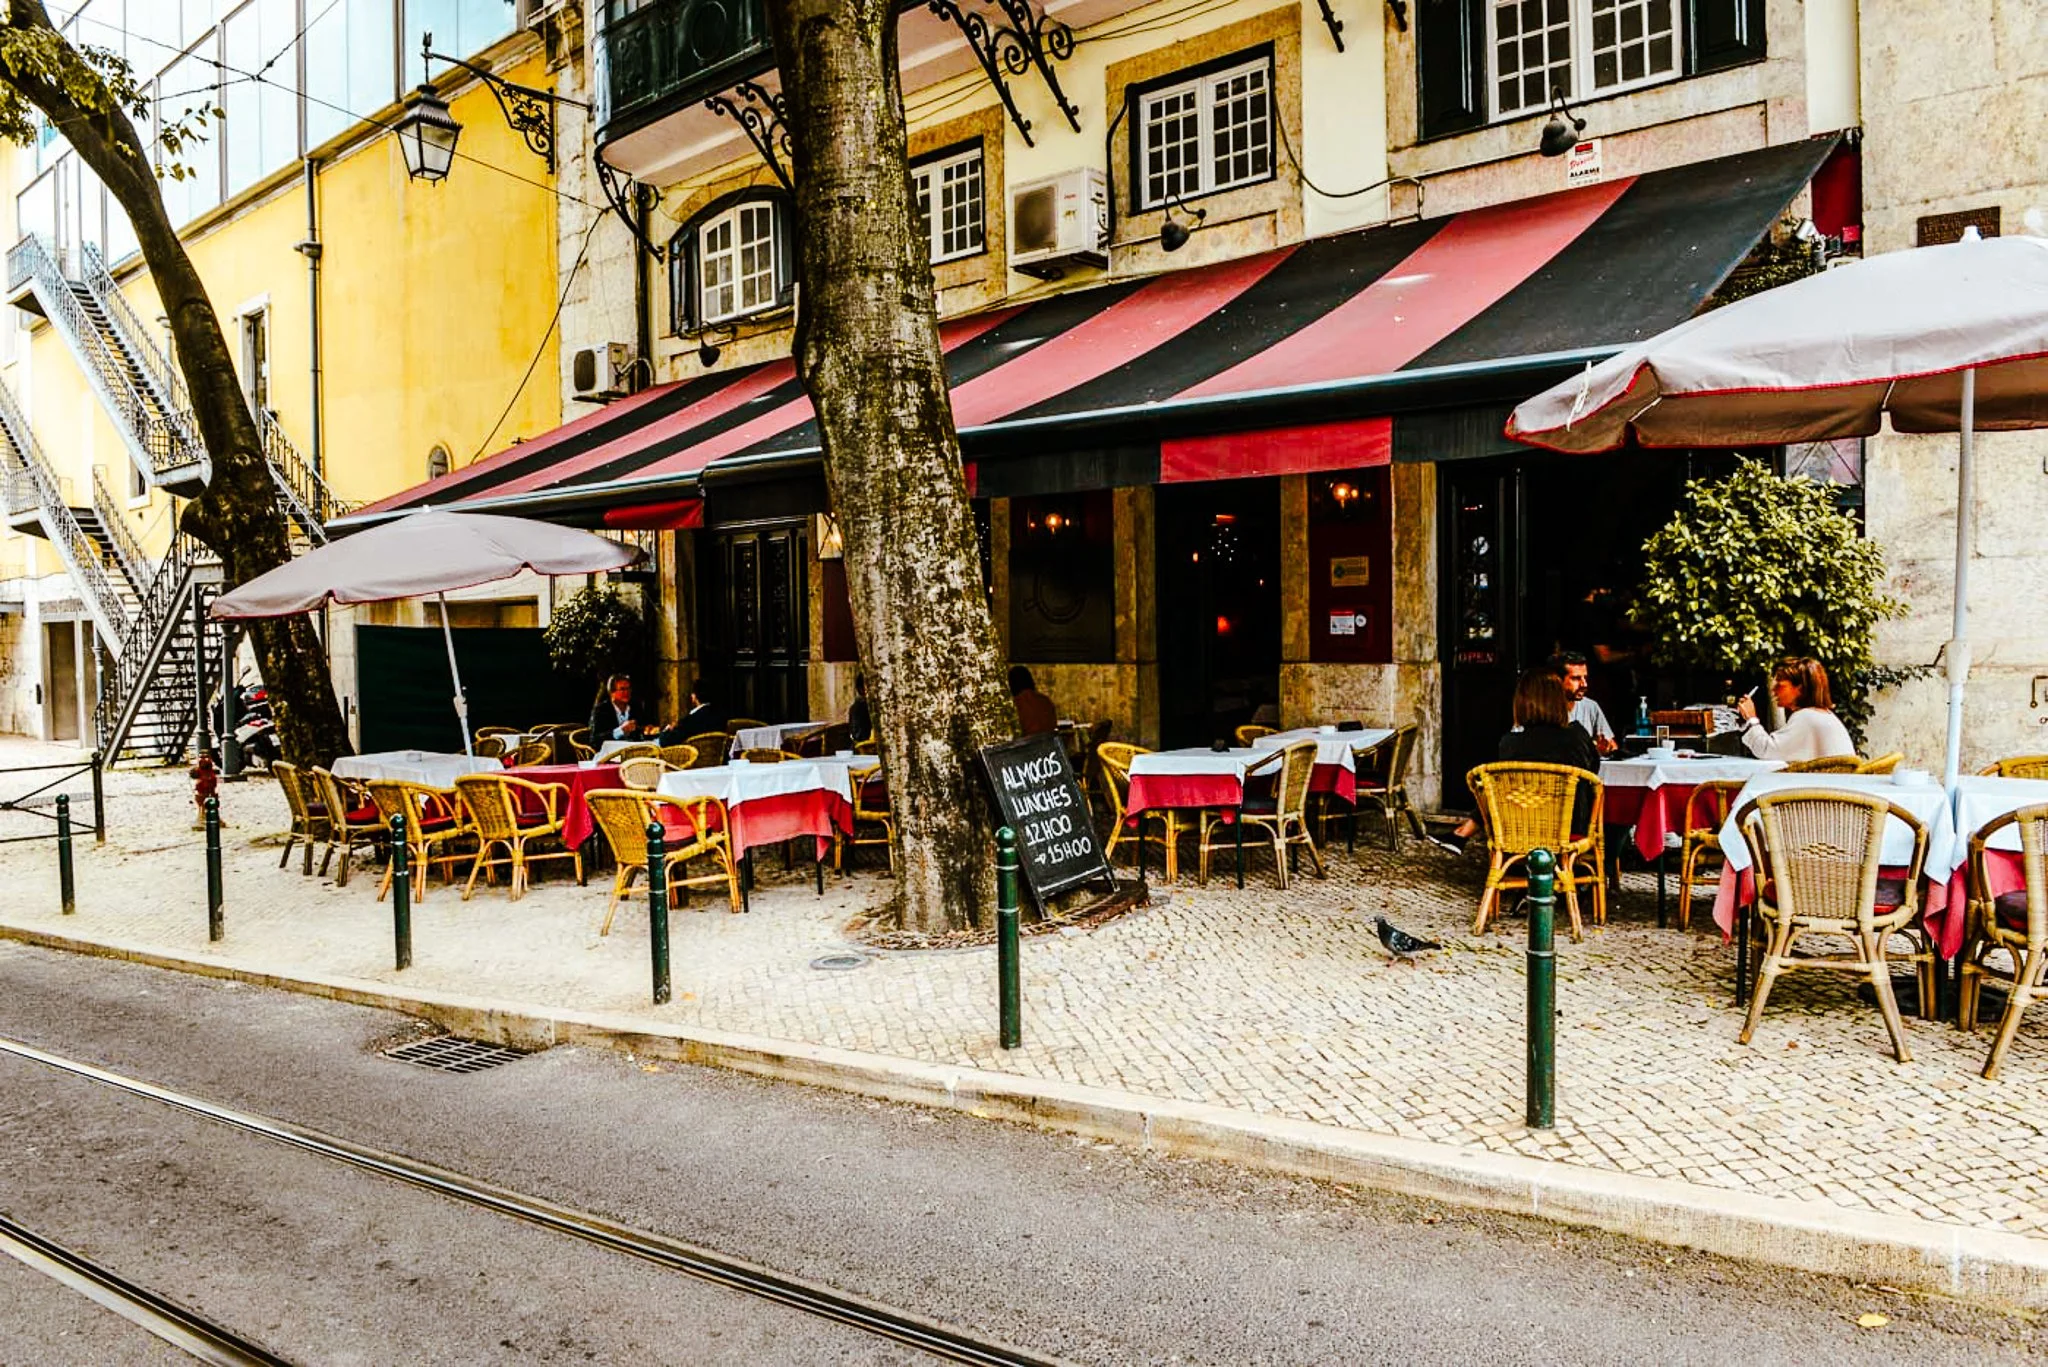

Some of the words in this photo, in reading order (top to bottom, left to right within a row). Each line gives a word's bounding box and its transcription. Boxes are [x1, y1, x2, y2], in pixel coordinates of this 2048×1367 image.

[1569, 166, 1600, 178] ALARME
[1001, 752, 1062, 791] ALMOÇOS
[1011, 784, 1072, 818] LUNCHES
